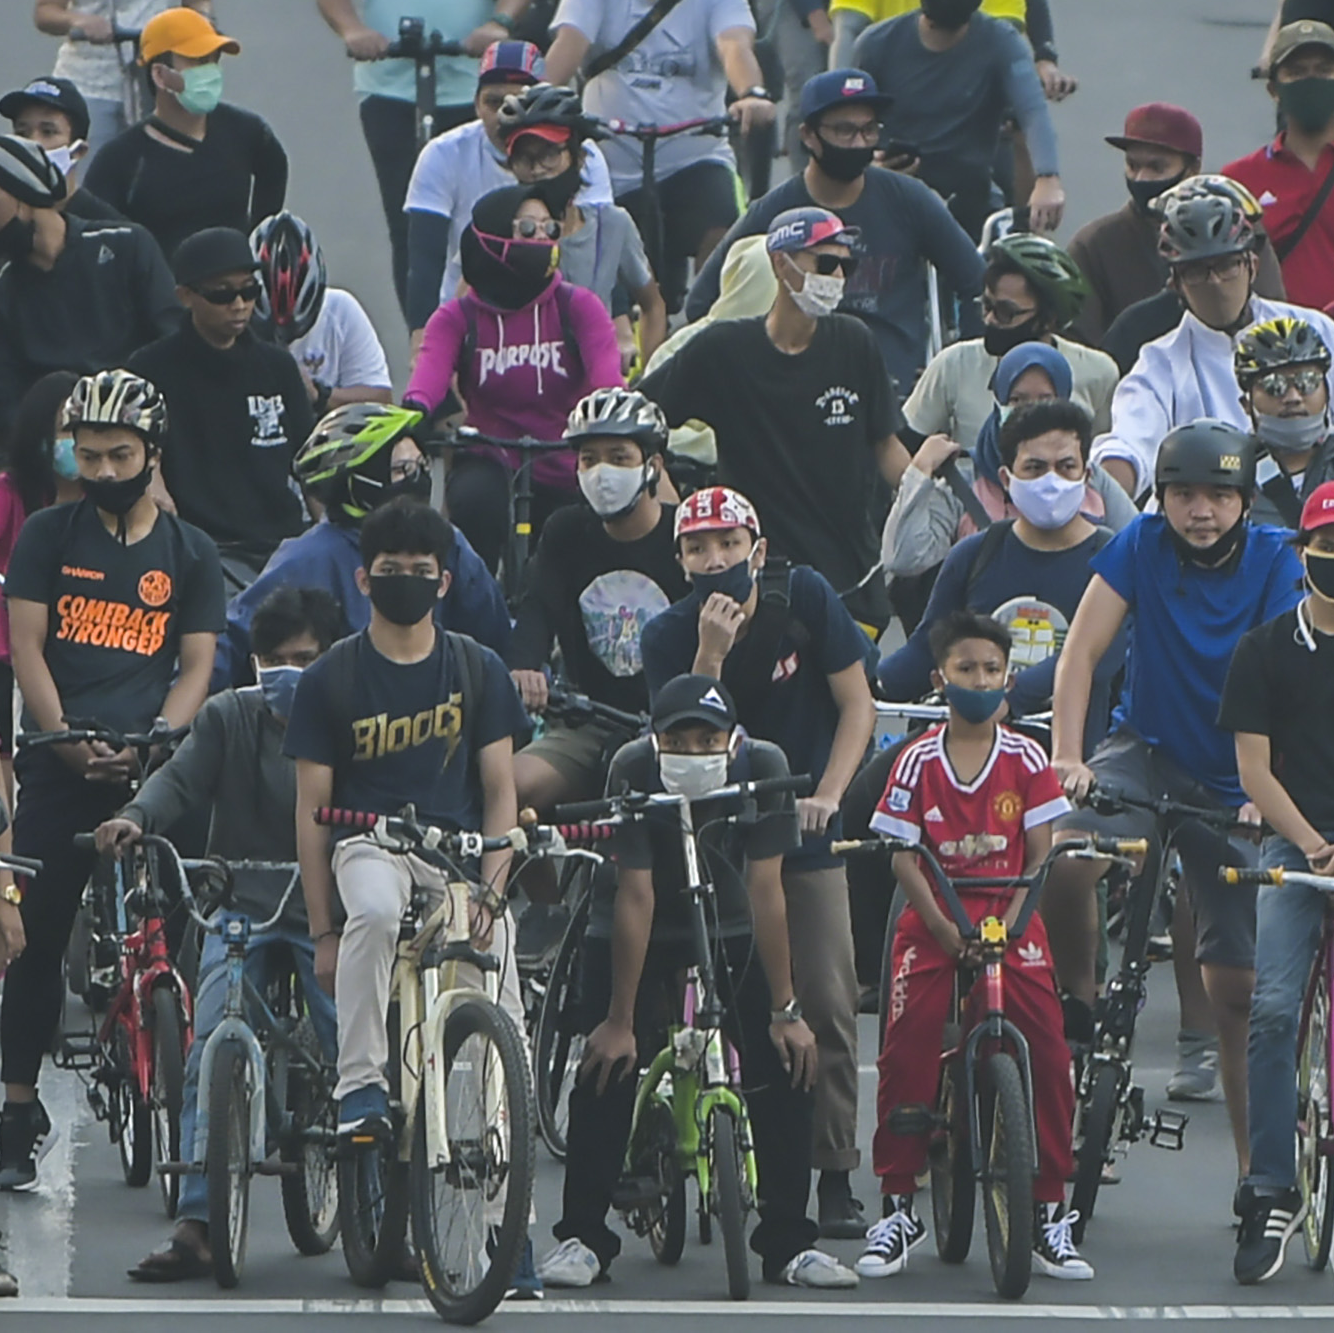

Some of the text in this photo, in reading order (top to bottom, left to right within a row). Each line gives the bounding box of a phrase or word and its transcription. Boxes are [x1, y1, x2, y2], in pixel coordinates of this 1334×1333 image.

[476, 341, 568, 387] PURPOSE
[56, 616, 165, 656] STRONGER
[57, 595, 171, 636] COMEBACK
